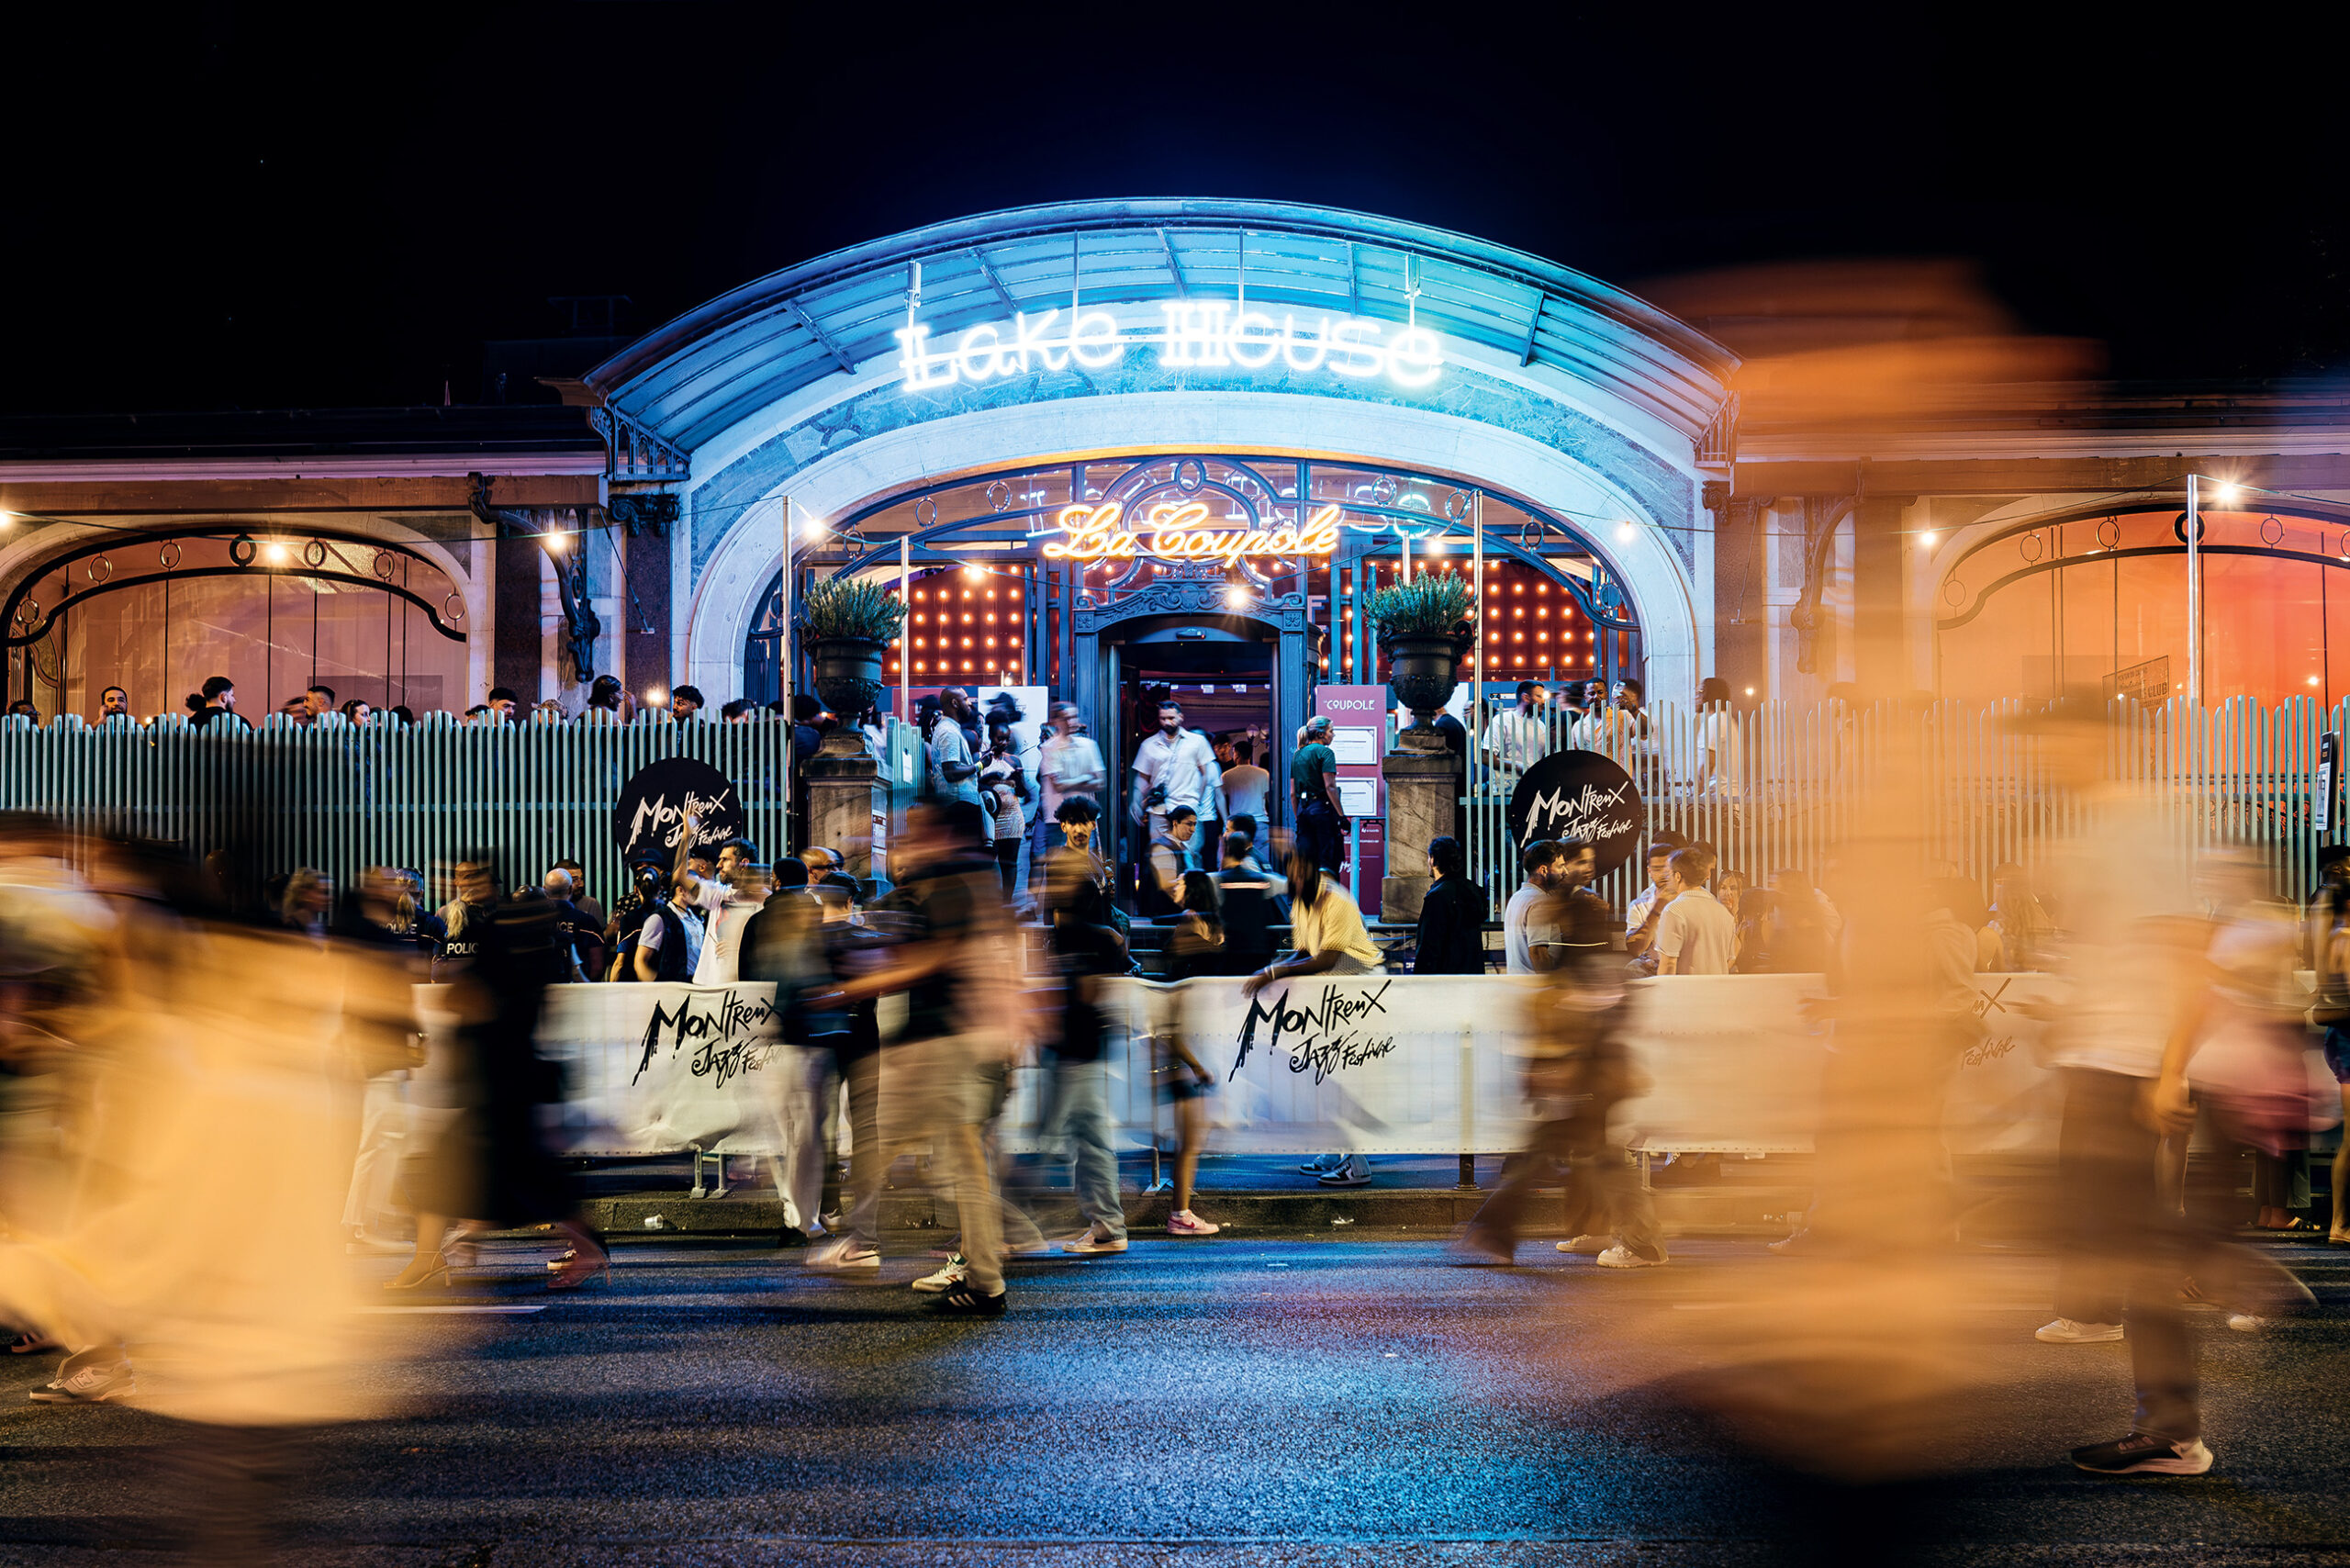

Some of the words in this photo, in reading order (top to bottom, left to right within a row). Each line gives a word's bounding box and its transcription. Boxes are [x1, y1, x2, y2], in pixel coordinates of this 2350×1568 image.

[894, 308, 1124, 391] Lake
[1159, 302, 1443, 387] House
[1042, 503, 1136, 558] La
[1147, 502, 1341, 569] Coupole
[1326, 699, 1375, 711] COUPOLE
